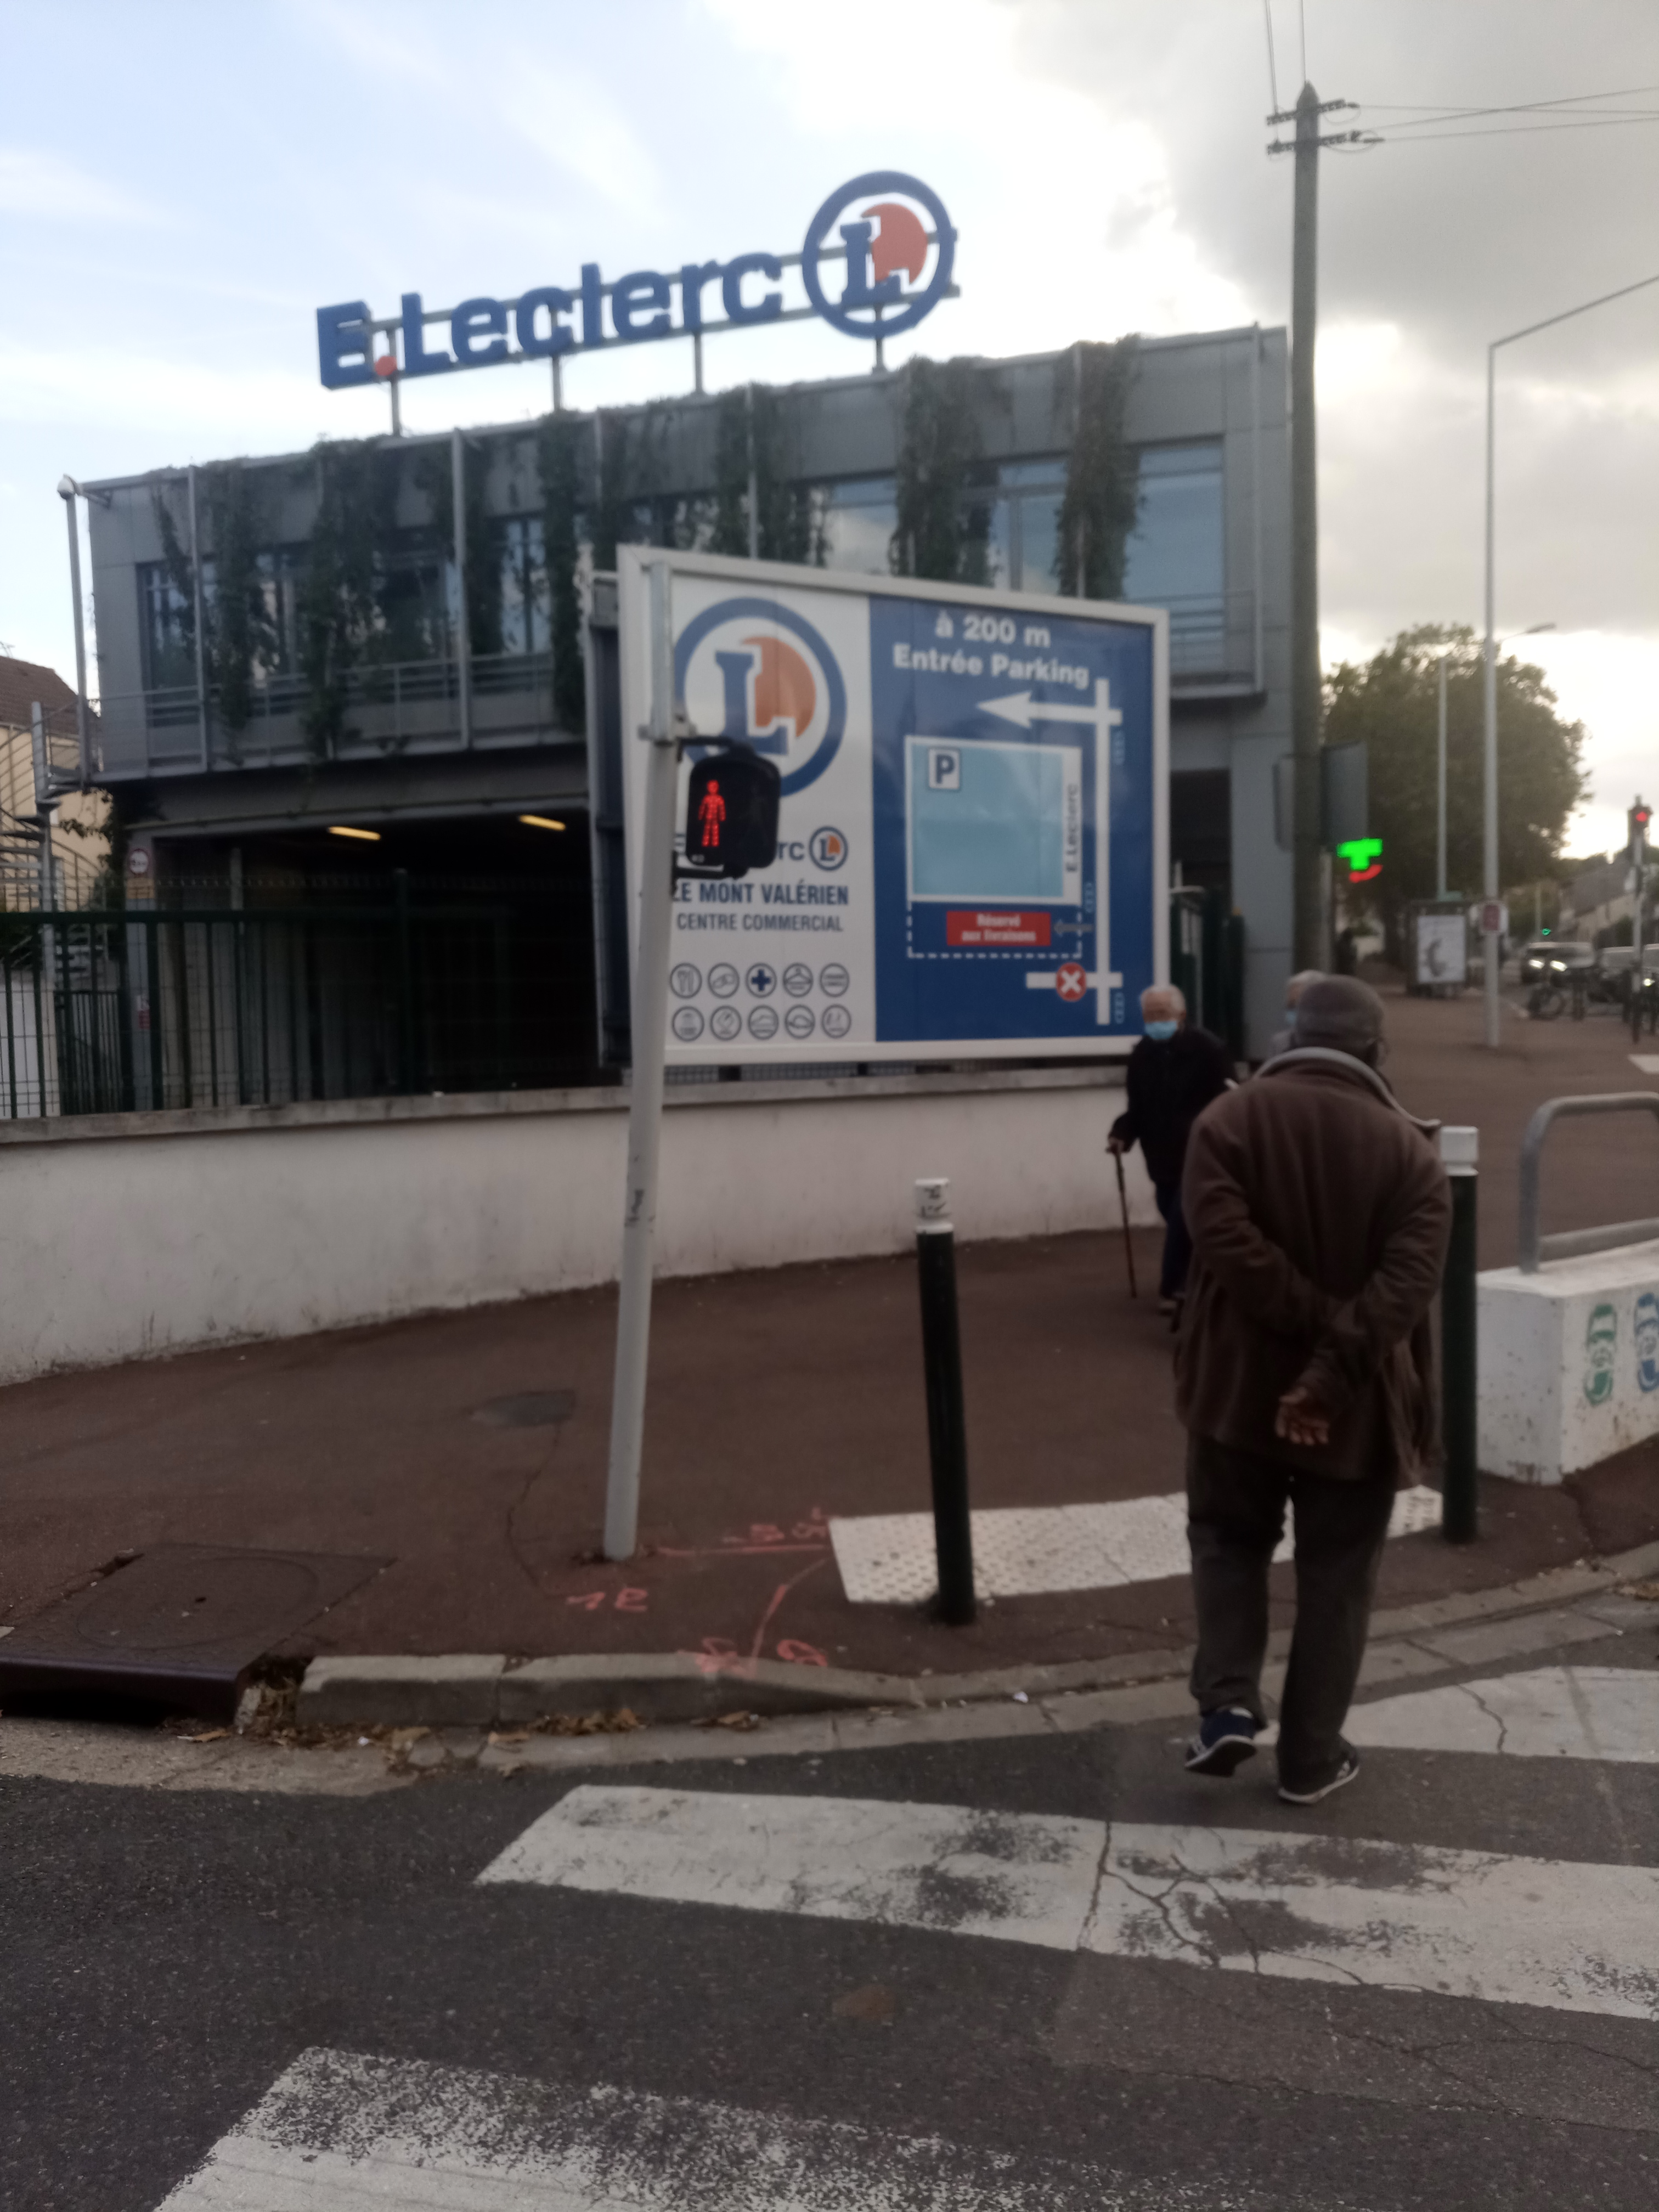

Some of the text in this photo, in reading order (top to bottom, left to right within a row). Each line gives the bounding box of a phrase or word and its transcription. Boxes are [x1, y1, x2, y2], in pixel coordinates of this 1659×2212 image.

[317, 252, 783, 390] E.Leclerc
[935, 609, 1051, 648] à 200 m
[893, 641, 1090, 690] Entrée Parking
[935, 754, 955, 785] P
[699, 883, 754, 904] MONT
[761, 879, 849, 905] VALÉRIEN
[676, 912, 844, 932] CENTRE COMMERCIAL
